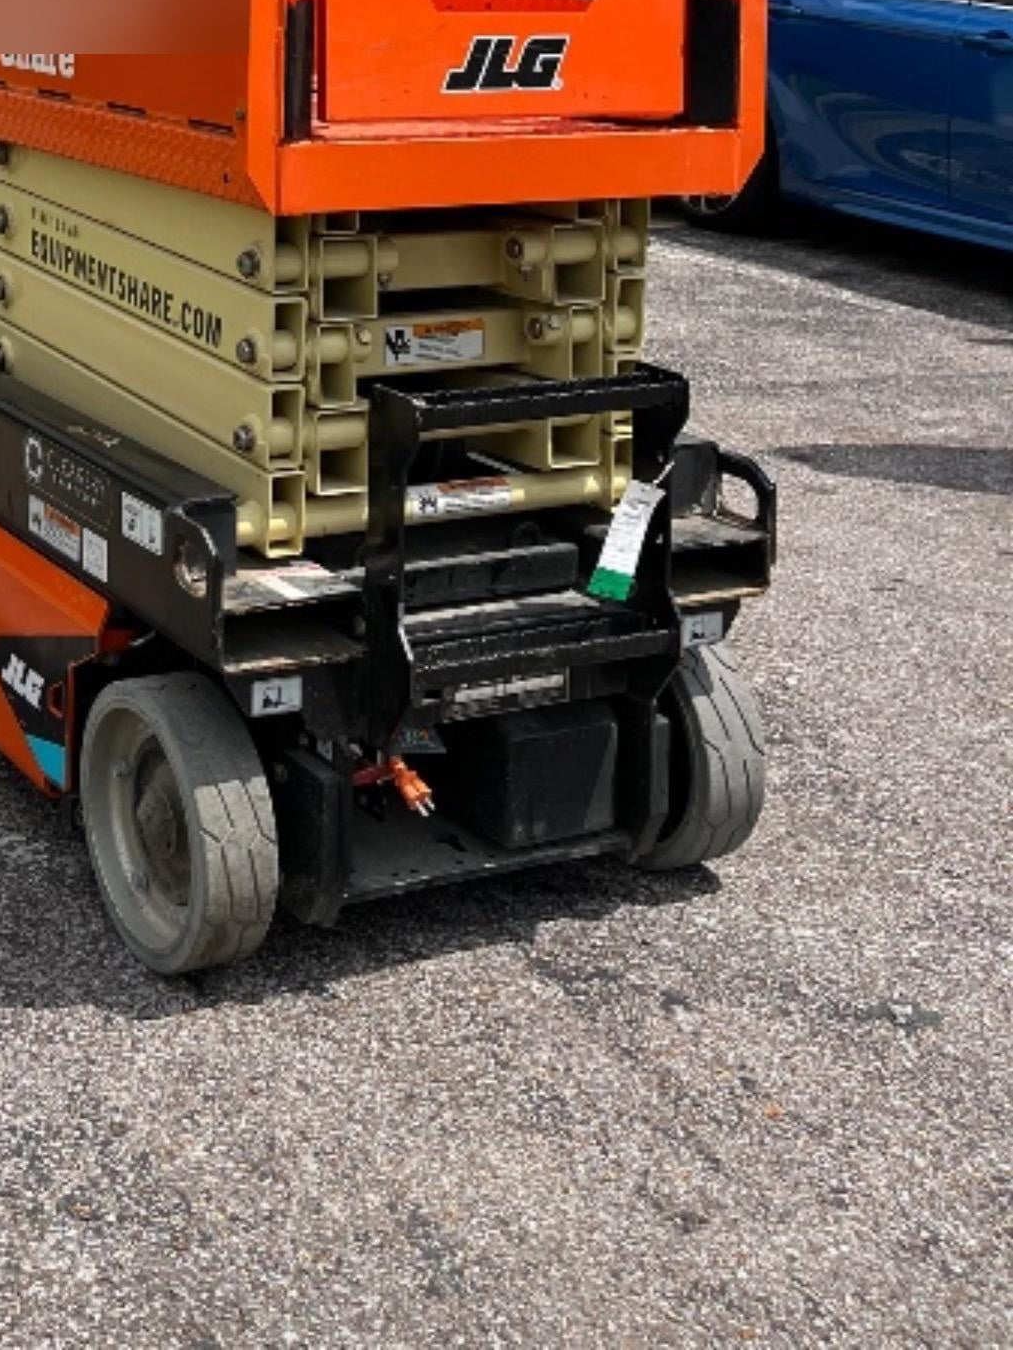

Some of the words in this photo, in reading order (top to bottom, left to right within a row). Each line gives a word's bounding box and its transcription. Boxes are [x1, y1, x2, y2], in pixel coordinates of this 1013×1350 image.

[440, 34, 570, 94] JLG
[30, 226, 224, 350] EQUIPMENTSHARE.COM
[1, 653, 45, 710] JLG
